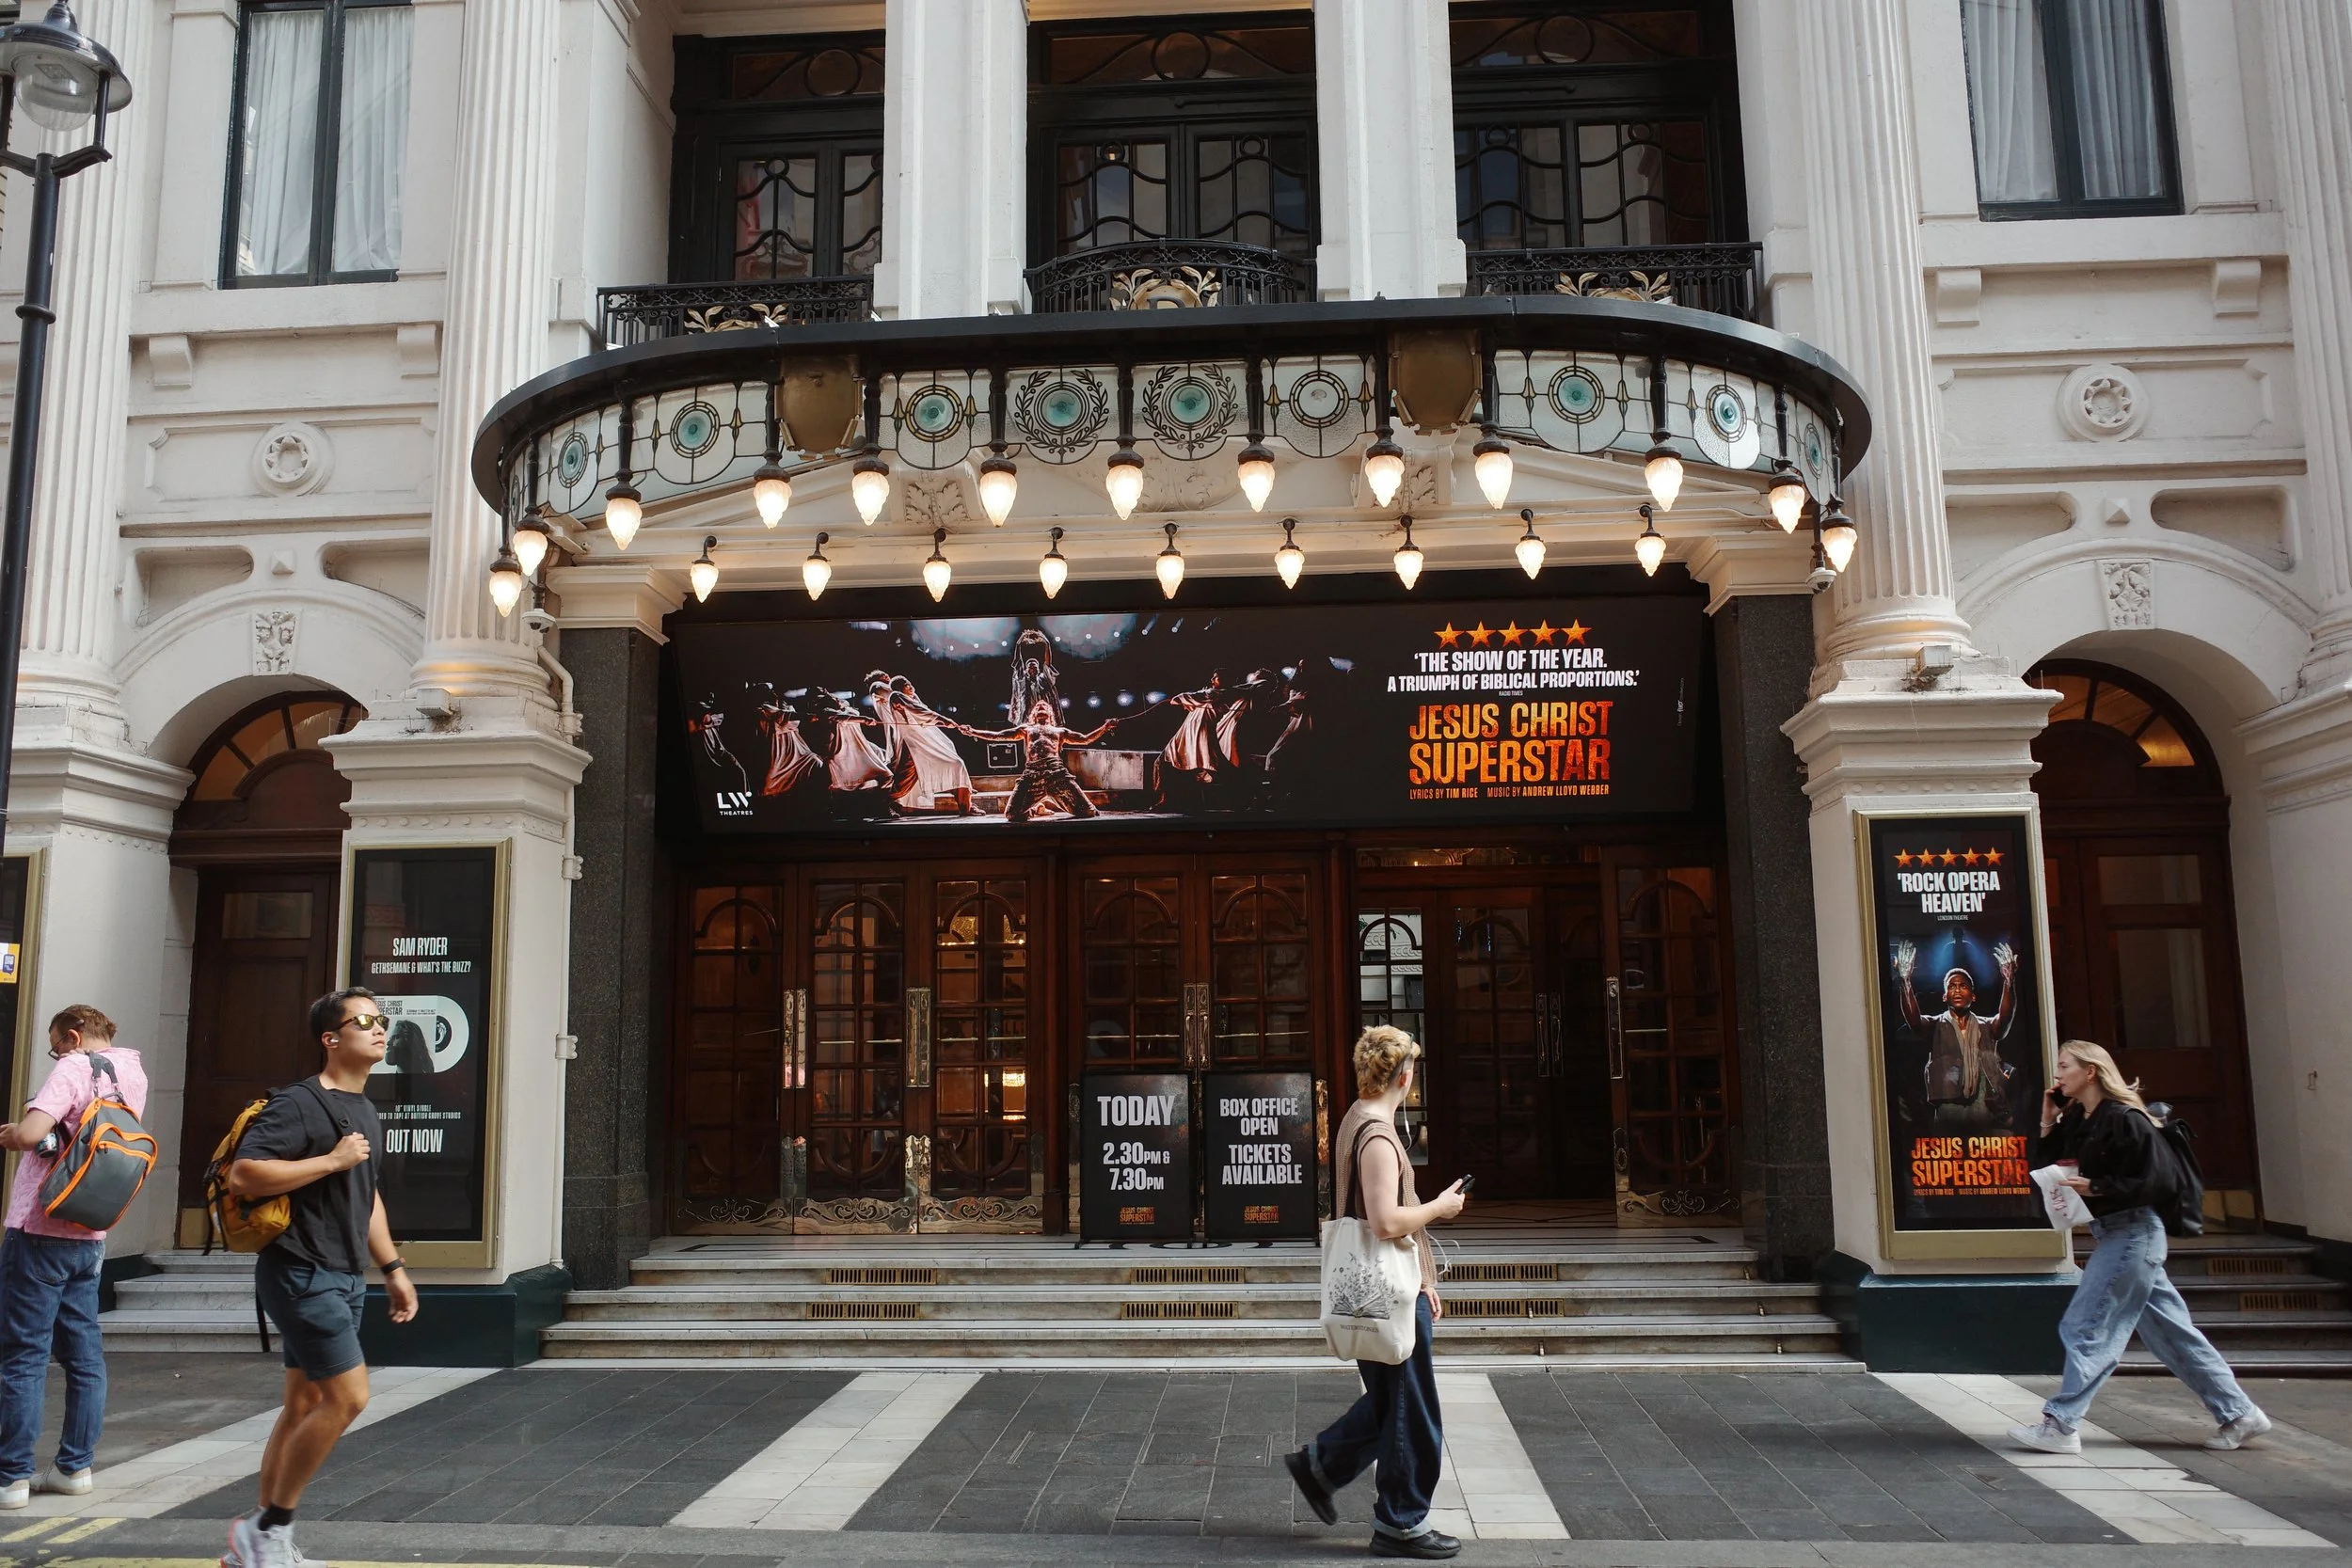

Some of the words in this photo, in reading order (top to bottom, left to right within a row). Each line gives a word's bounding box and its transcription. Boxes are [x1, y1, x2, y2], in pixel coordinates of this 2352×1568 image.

[1414, 652, 1449, 673] ‘THE
[1452, 651, 1503, 672] SHOW
[1506, 650, 1526, 670] OF
[1529, 649, 1559, 670] THE
[1563, 648, 1607, 669] YEAR.
[1388, 675, 1396, 692] A
[1399, 674, 1459, 691] TRIUMPH
[1462, 673, 1478, 690] OF
[1480, 673, 1537, 689] BIBLICAL
[1409, 703, 1500, 740] JESUS
[1510, 701, 1613, 737] CHRIST
[1409, 739, 1611, 785] SUPERSTAR
[717, 791, 753, 809] LW
[1409, 789, 1434, 800] LYRICS
[1436, 788, 1444, 799] BY
[1446, 788, 1458, 799] TIM
[1462, 787, 1478, 798] RICE
[1486, 787, 1511, 798] MUSIC
[1512, 786, 1520, 797] BY
[1522, 785, 1553, 797] ANDREW
[1555, 785, 1577, 796] LLOYD
[1580, 784, 1610, 796] WEBBER
[1898, 872, 1946, 893] 'ROCK
[1947, 871, 2001, 892] OPERA
[1921, 892, 1986, 913] HEAVEN'
[392, 937, 416, 956] SAM
[417, 937, 448, 956] RYDER
[371, 961, 410, 974] GETHSEMANE
[411, 961, 416, 974] &
[417, 961, 440, 974] WHAT'S
[441, 961, 452, 973] THE
[452, 961, 471, 973] BUZZ?
[378, 1006, 403, 1016] PERSTAR
[1097, 1095, 1176, 1127] TODAY
[1220, 1098, 1249, 1117] BOX
[1251, 1097, 1298, 1116] OFFICE
[1240, 1117, 1279, 1136] OPEN
[386, 1129, 410, 1153] OUT
[412, 1129, 443, 1153] NOW
[1911, 1136, 1963, 1160] JESUS
[1968, 1136, 2027, 1159] CHRIST
[1103, 1142, 1161, 1165] 2.30PM
[1163, 1150, 1170, 1164] &
[1228, 1144, 1292, 1164] TICKETS
[1109, 1167, 1165, 1191] 7.30PM
[1222, 1164, 1302, 1185] AVAILABLE
[1912, 1159, 2030, 1187] SUPERSTAR
[1120, 1213, 1155, 1222] SUPERSTAR
